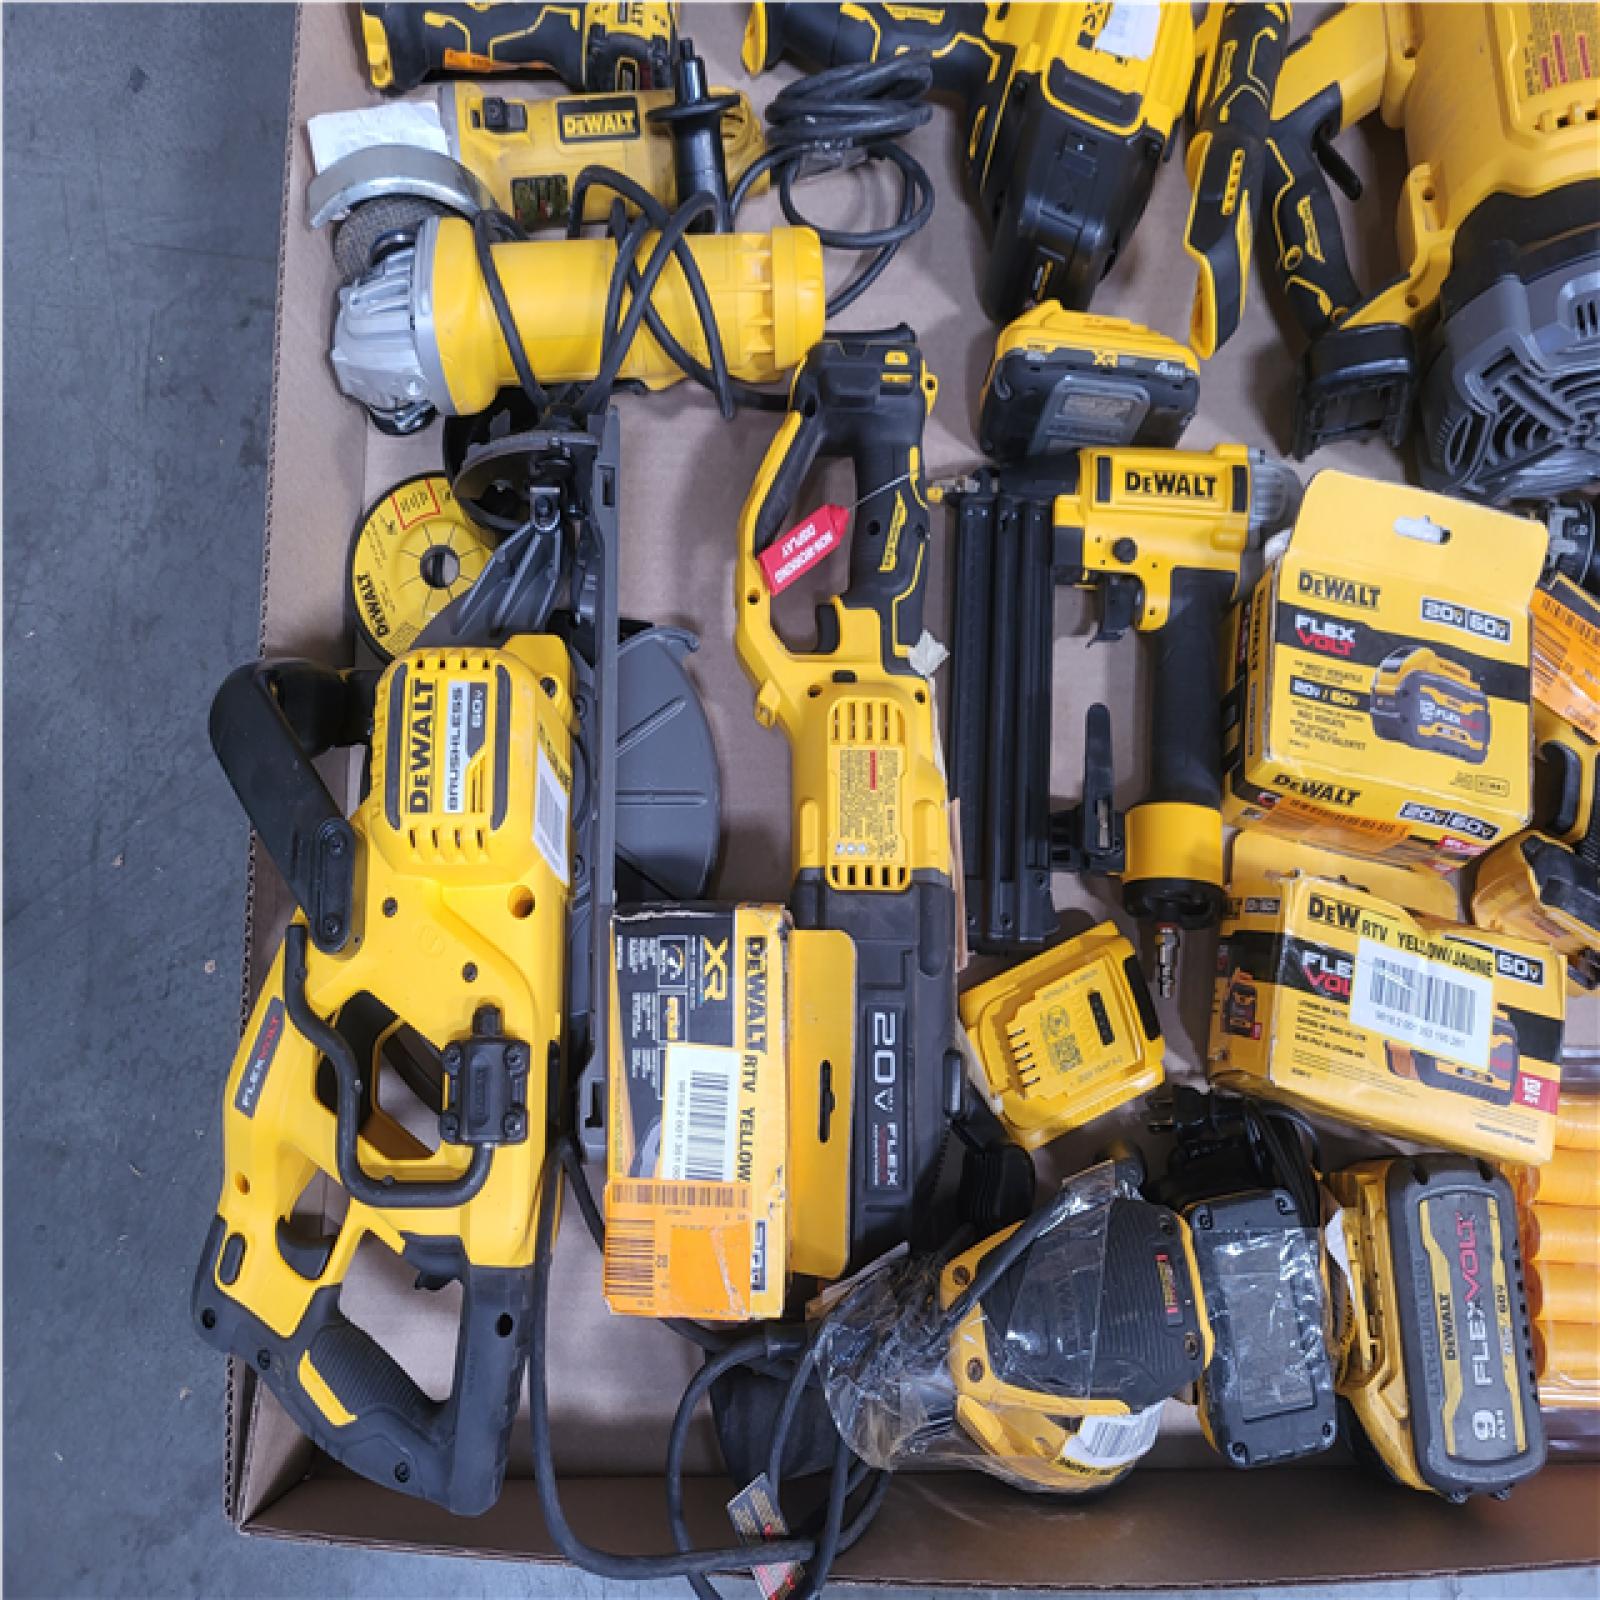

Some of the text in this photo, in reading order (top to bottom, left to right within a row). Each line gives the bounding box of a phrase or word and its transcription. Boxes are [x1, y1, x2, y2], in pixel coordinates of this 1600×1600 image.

[1295, 613, 1356, 644] FLEX
[1296, 628, 1356, 656] VOLT
[447, 686, 464, 811] BRUSHLESS
[1361, 919, 1389, 942] RTV
[704, 937, 729, 1001] XR
[1302, 949, 1354, 979] FLE
[1302, 965, 1351, 997] VOL
[742, 1055, 758, 1093] RTV
[874, 1011, 897, 1113] 20V
[1472, 1409, 1496, 1441] 9
